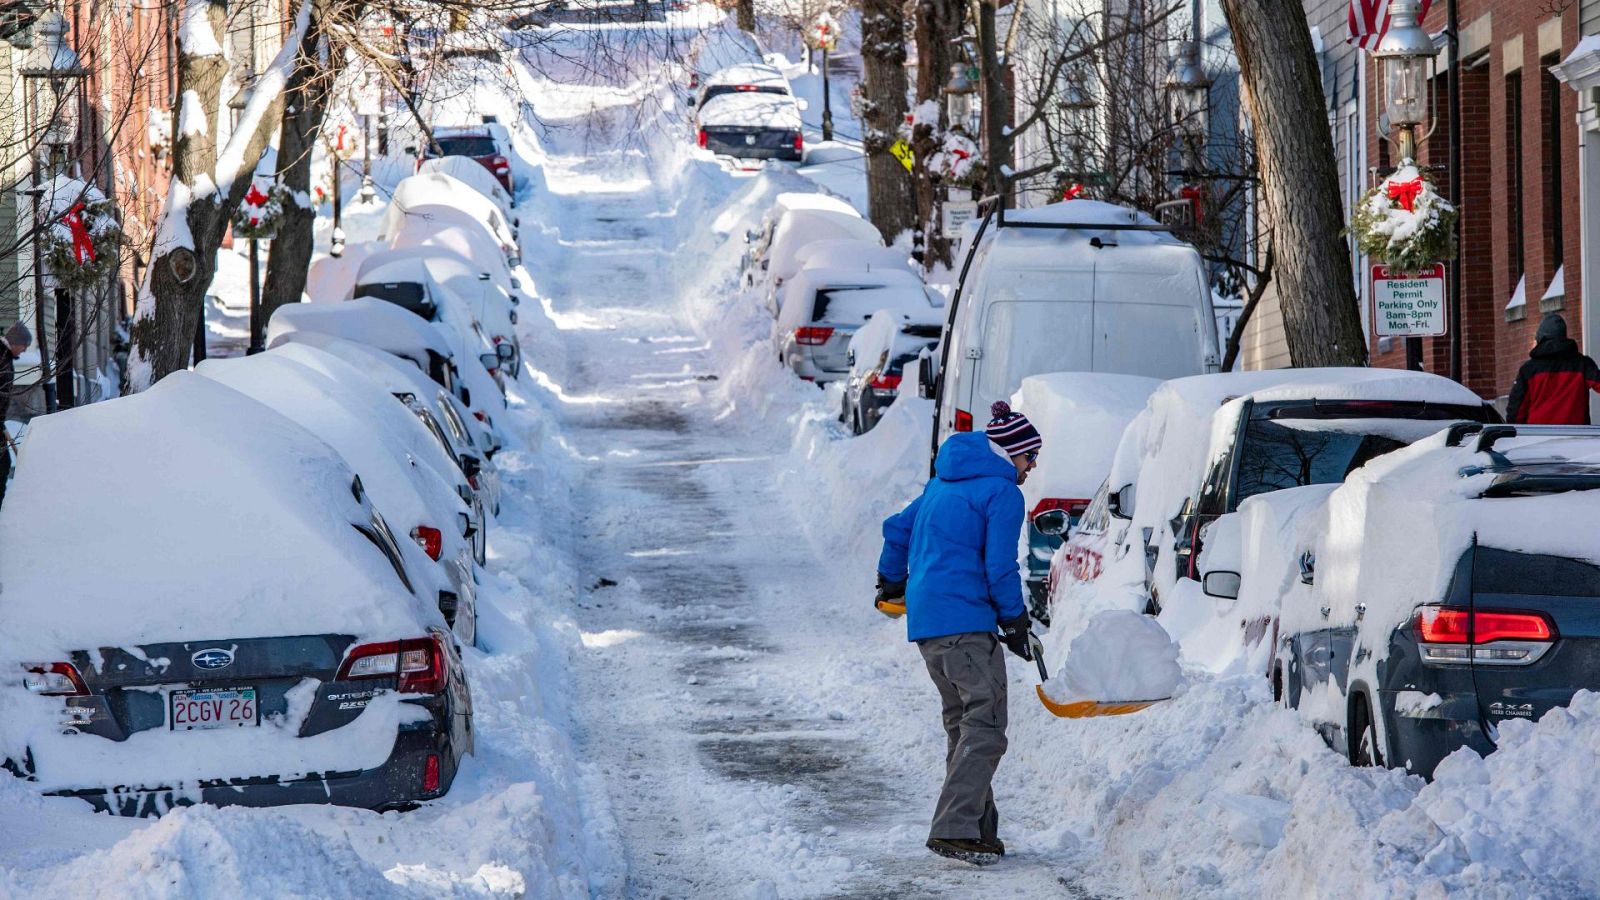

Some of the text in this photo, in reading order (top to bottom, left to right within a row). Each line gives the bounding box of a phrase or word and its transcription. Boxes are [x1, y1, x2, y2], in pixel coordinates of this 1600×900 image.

[1387, 280, 1429, 289] Resident
[1393, 290, 1423, 299] Permit
[1379, 300, 1438, 310] Parking Only
[1386, 310, 1432, 319] 8am-8pm
[1389, 320, 1430, 329] Mon.-Fri.
[175, 699, 253, 723] 2CGV 26
